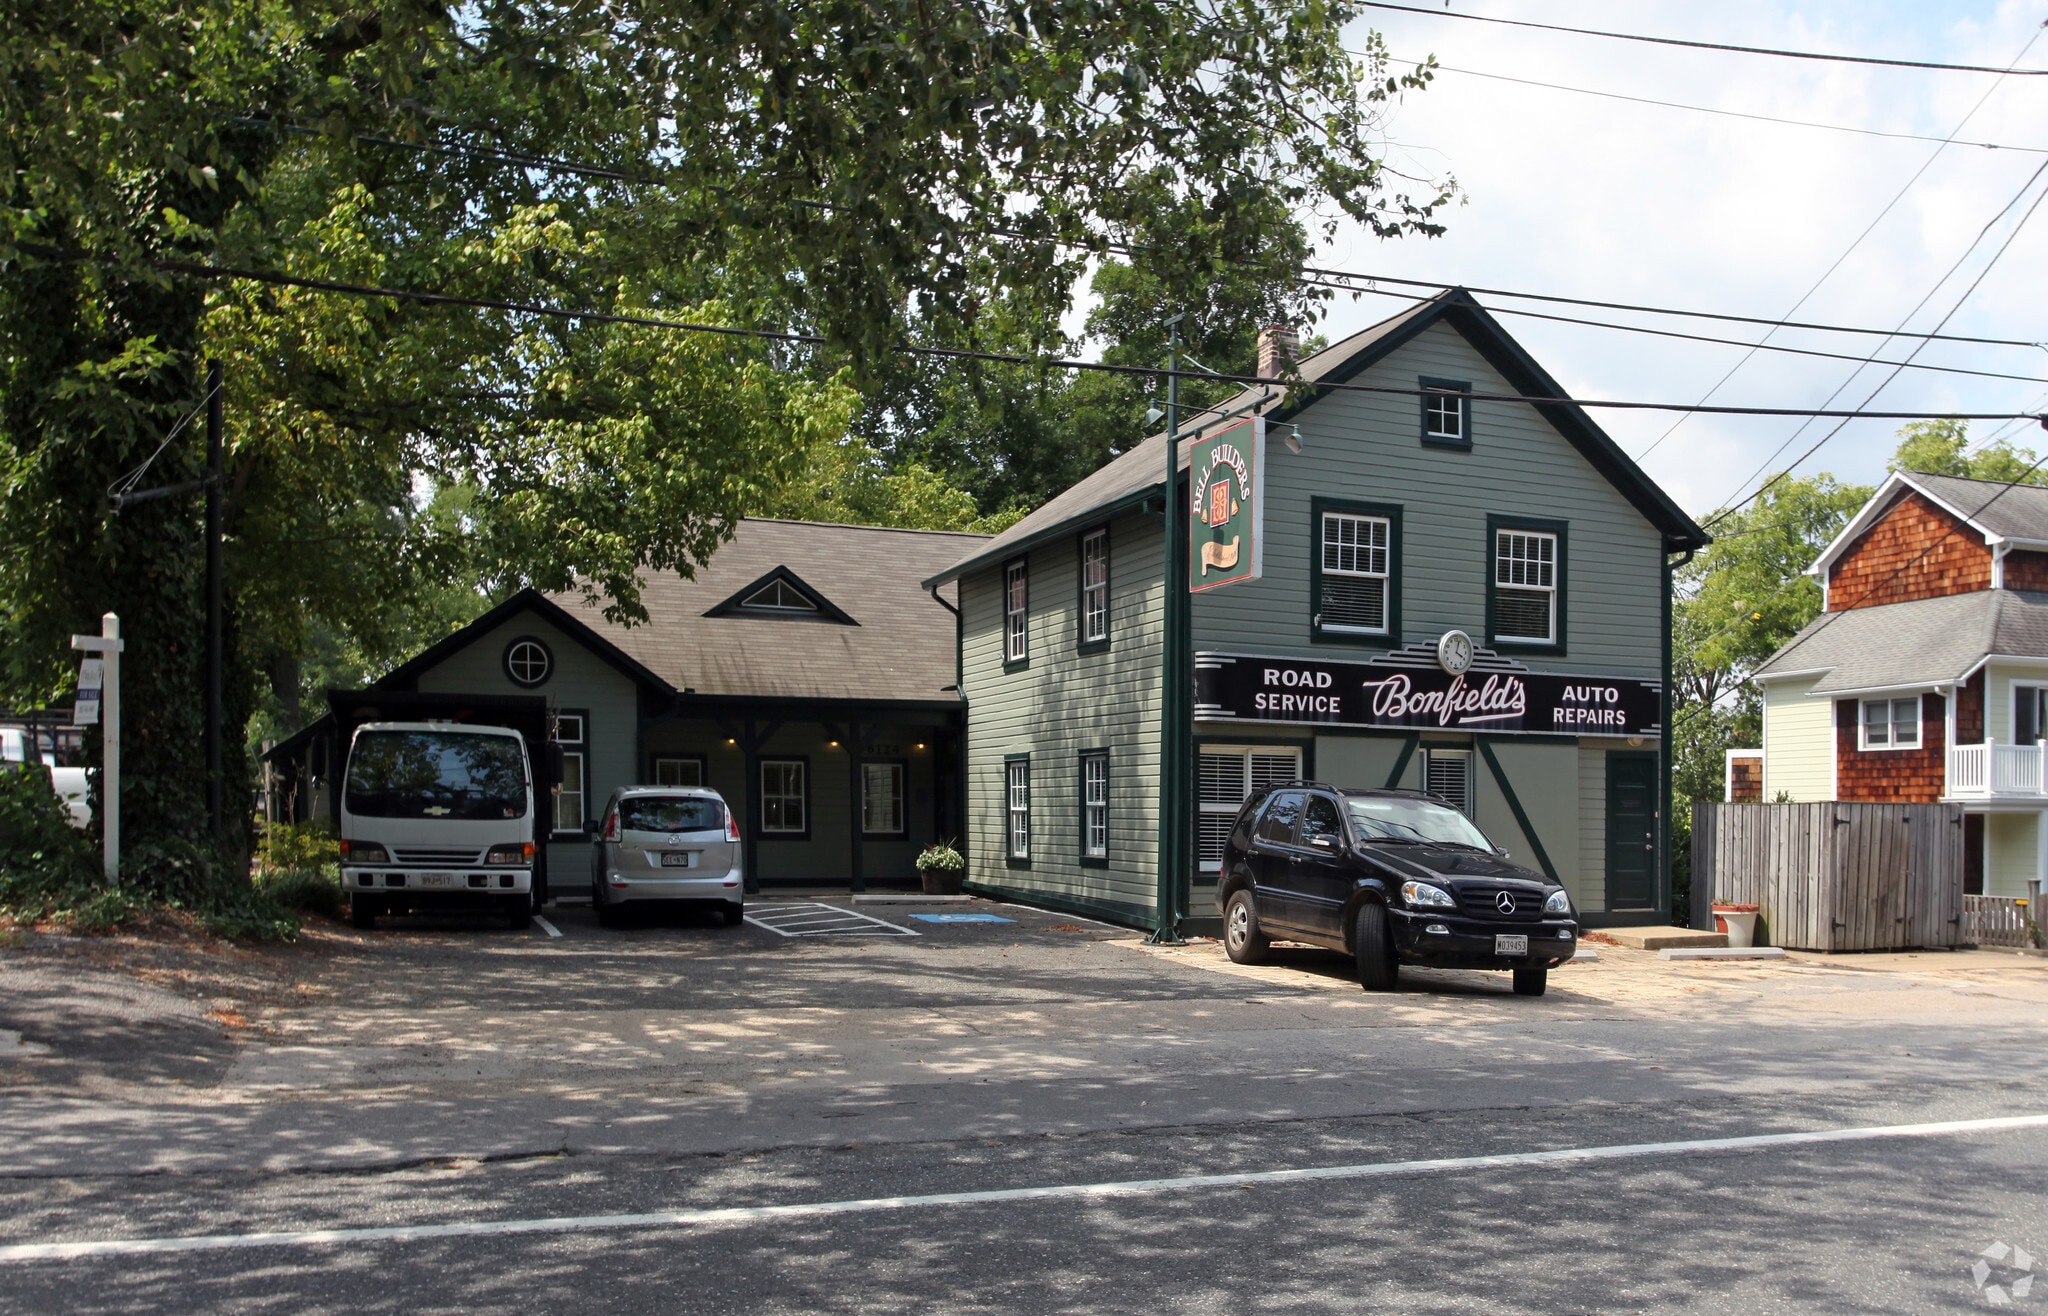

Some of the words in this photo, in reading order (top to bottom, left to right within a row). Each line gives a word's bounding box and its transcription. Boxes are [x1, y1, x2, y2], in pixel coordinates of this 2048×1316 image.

[1192, 465, 1211, 514] BELL
[1210, 444, 1250, 500] BUILDERS
[1263, 668, 1332, 688] ROAD
[1255, 692, 1341, 713] SERVICE
[1362, 674, 1526, 726] Bonfield's
[1561, 685, 1619, 703] AUTO
[1553, 707, 1626, 725] REPAIRS
[867, 743, 900, 754] 6124
